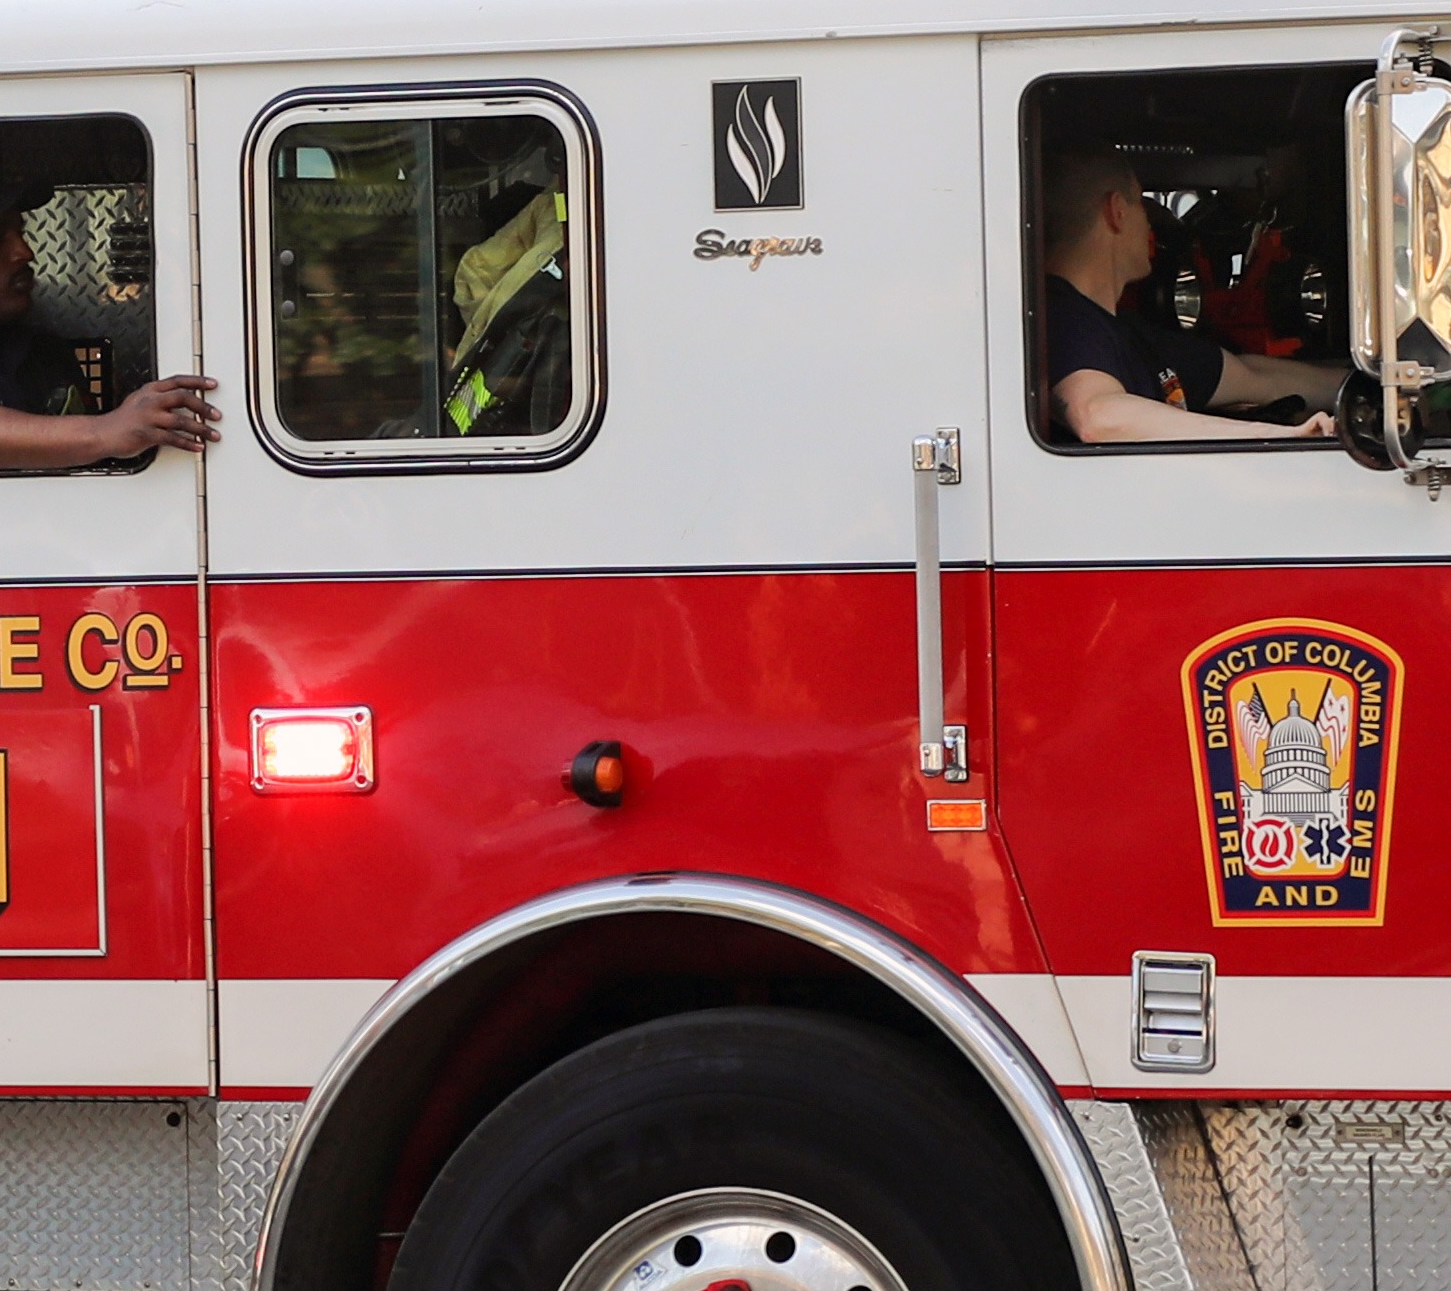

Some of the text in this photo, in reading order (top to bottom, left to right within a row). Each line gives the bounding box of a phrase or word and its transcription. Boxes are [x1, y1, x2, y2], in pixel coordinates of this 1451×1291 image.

[1203, 641, 1380, 749] DISTRICT OF COLUMBIA
[1214, 791, 1244, 879] FIRE
[1350, 789, 1376, 879] EMS
[1255, 885, 1339, 907] AND
